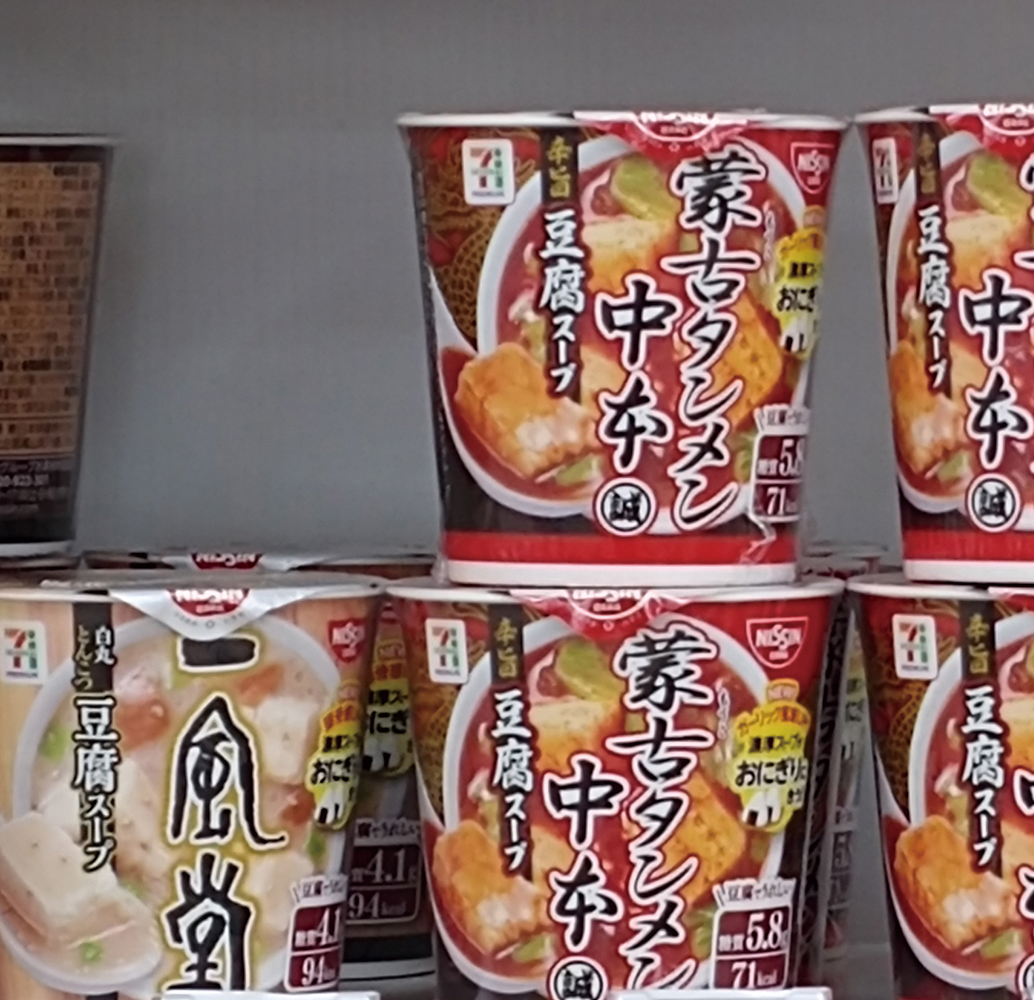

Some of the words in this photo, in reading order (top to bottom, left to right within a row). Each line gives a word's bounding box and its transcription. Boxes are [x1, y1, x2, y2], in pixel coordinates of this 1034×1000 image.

[539, 209, 586, 393] 豆腐スープ
[596, 278, 682, 473] 中本
[663, 144, 767, 529] 蒙古タンメン
[916, 205, 952, 388] 豆腐スープ
[72, 696, 119, 870] 豆腐スープ
[163, 636, 287, 990] 一風堂
[491, 689, 534, 869] 豆腐スープ
[544, 755, 627, 949] 中本
[606, 622, 717, 987] 蒙古タンメン
[961, 687, 1005, 864] 豆腐スープ
